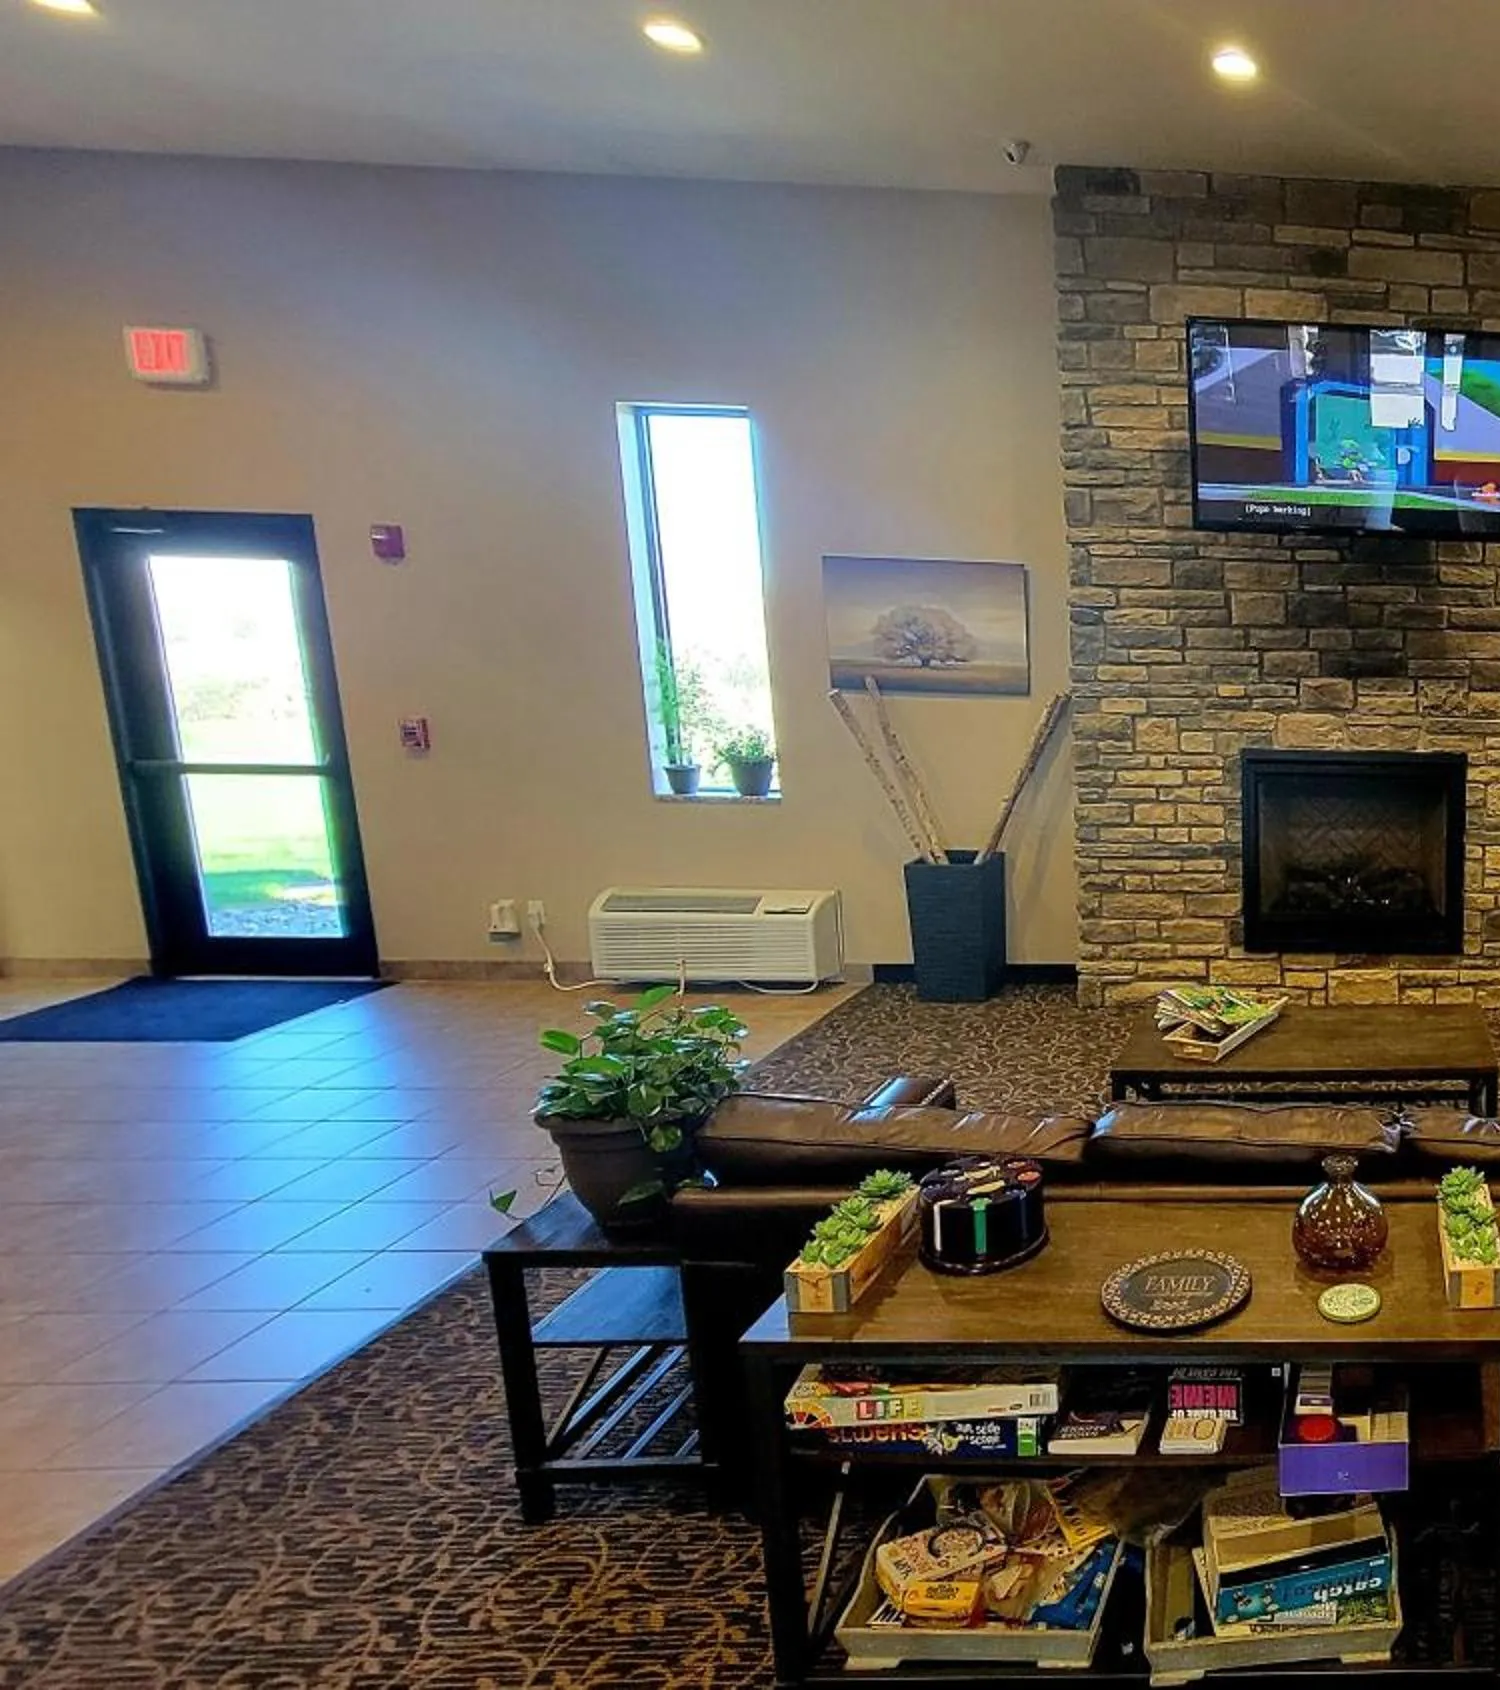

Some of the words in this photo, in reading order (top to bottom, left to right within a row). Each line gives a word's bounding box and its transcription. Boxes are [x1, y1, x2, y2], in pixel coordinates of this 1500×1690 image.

[1144, 1274, 1217, 1294] FAMILY
[1171, 1384, 1237, 1408] MEME
[857, 1399, 921, 1420] LIFE
